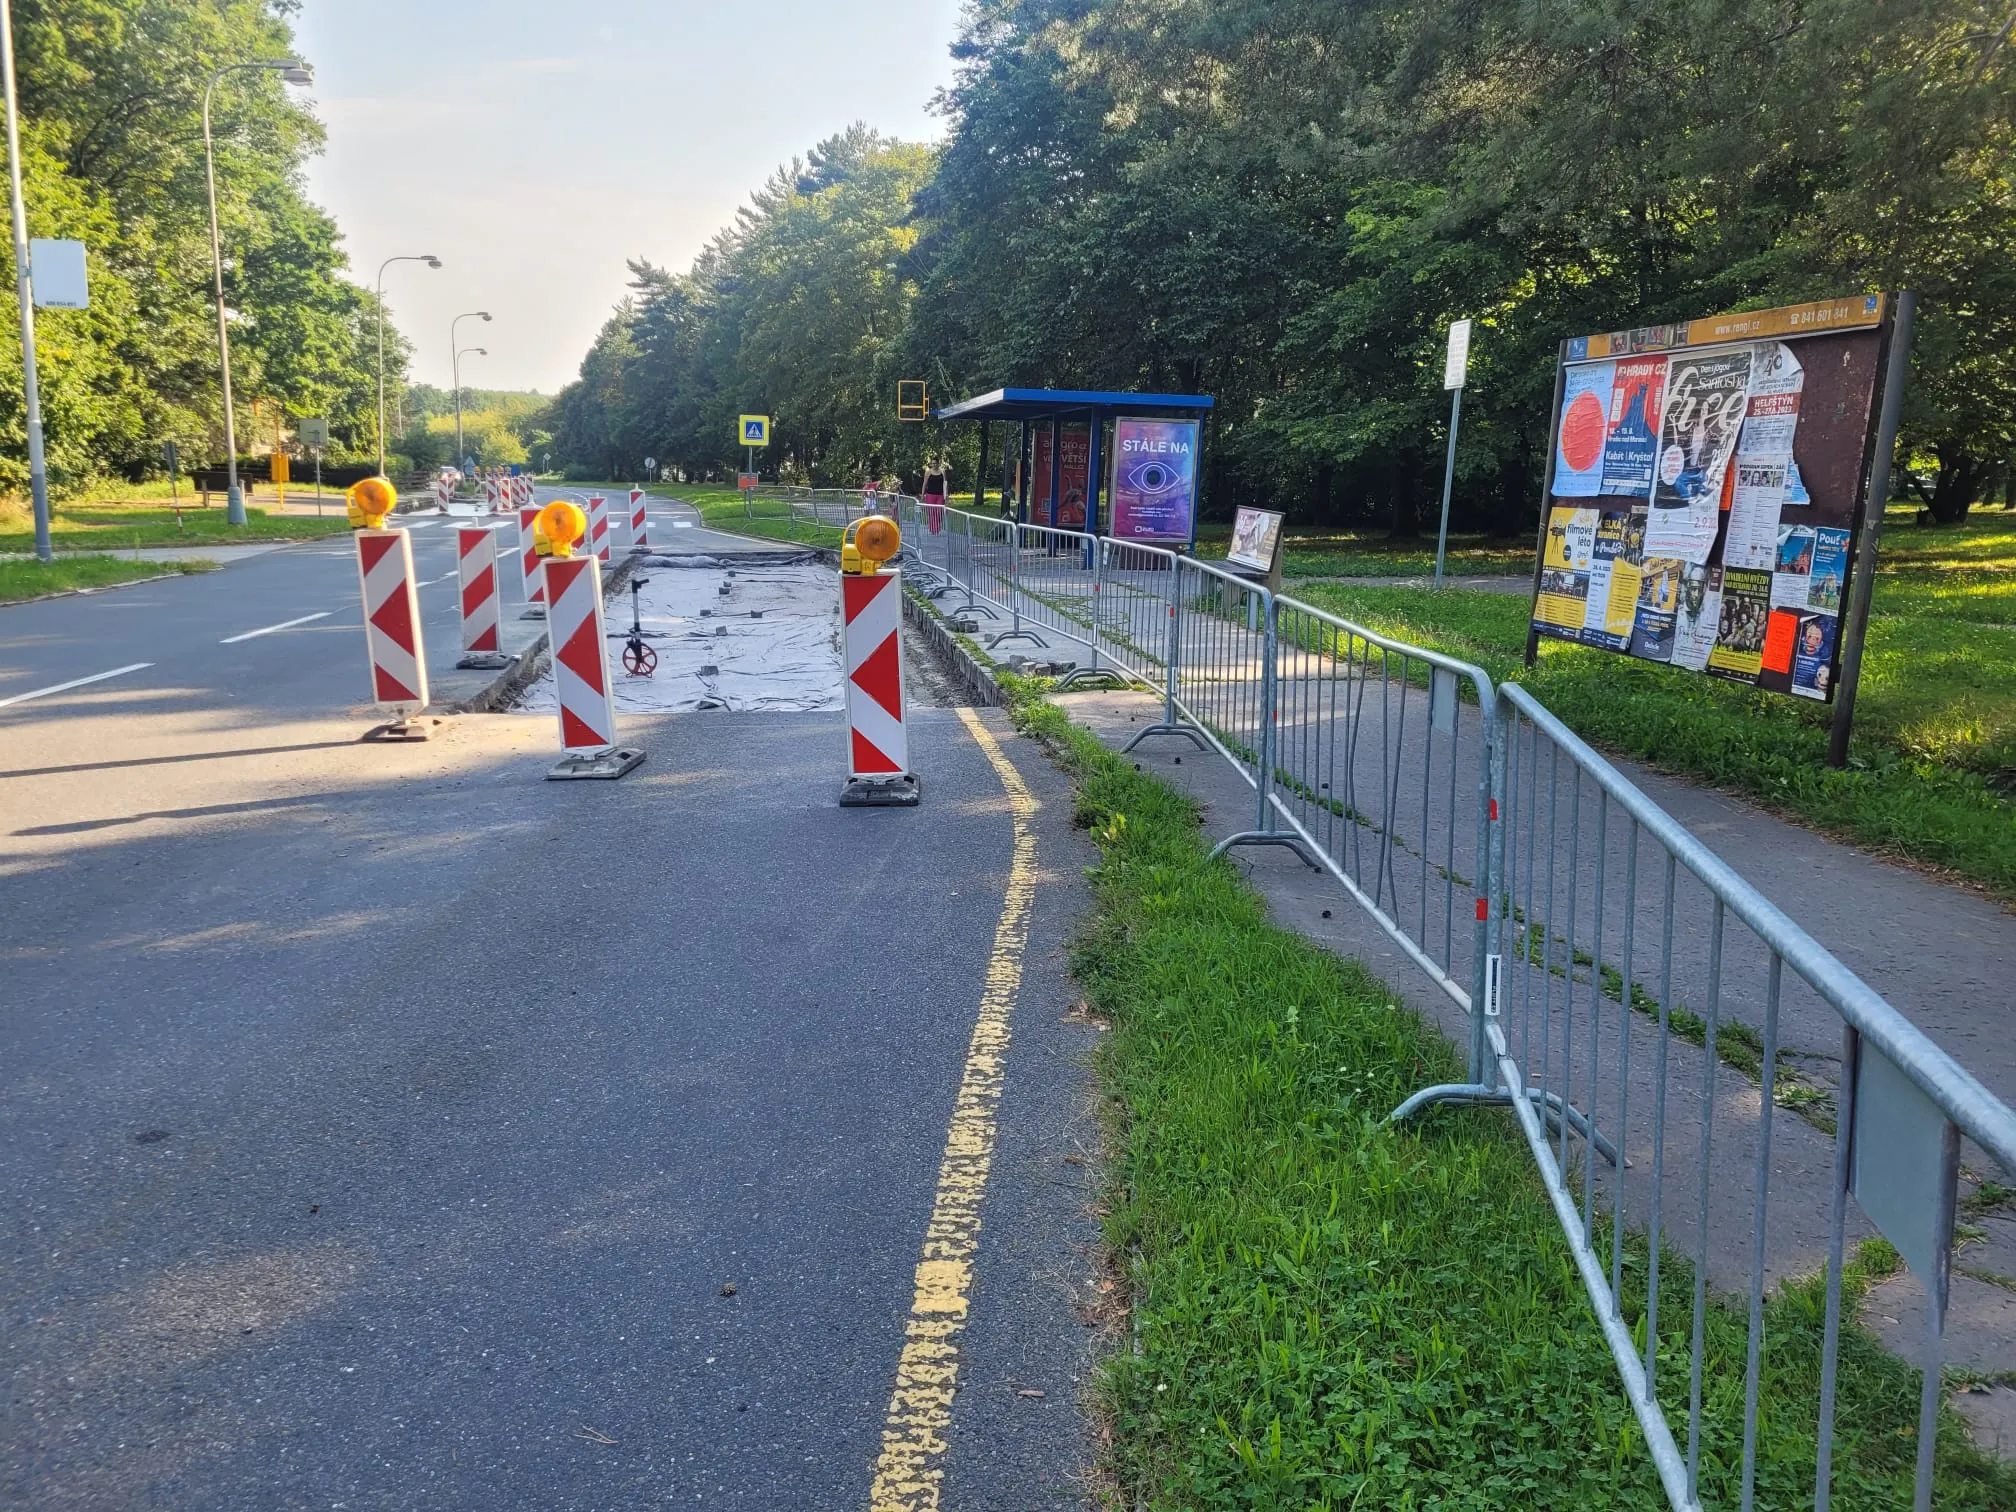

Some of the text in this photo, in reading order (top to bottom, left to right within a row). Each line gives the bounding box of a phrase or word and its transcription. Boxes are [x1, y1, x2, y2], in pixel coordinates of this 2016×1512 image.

[1801, 310, 1815, 324] 841
[1817, 308, 1831, 322] 601
[1715, 320, 1760, 335] www.rengl.cz
[1626, 363, 1667, 377] HRADY CZ
[1755, 394, 1794, 408] HELFŠTÝN
[1122, 437, 1189, 454] STÁLE NA
[1566, 523, 1593, 536] filmové
[1577, 535, 1592, 548] léto
[1819, 533, 1842, 545] Pouť
